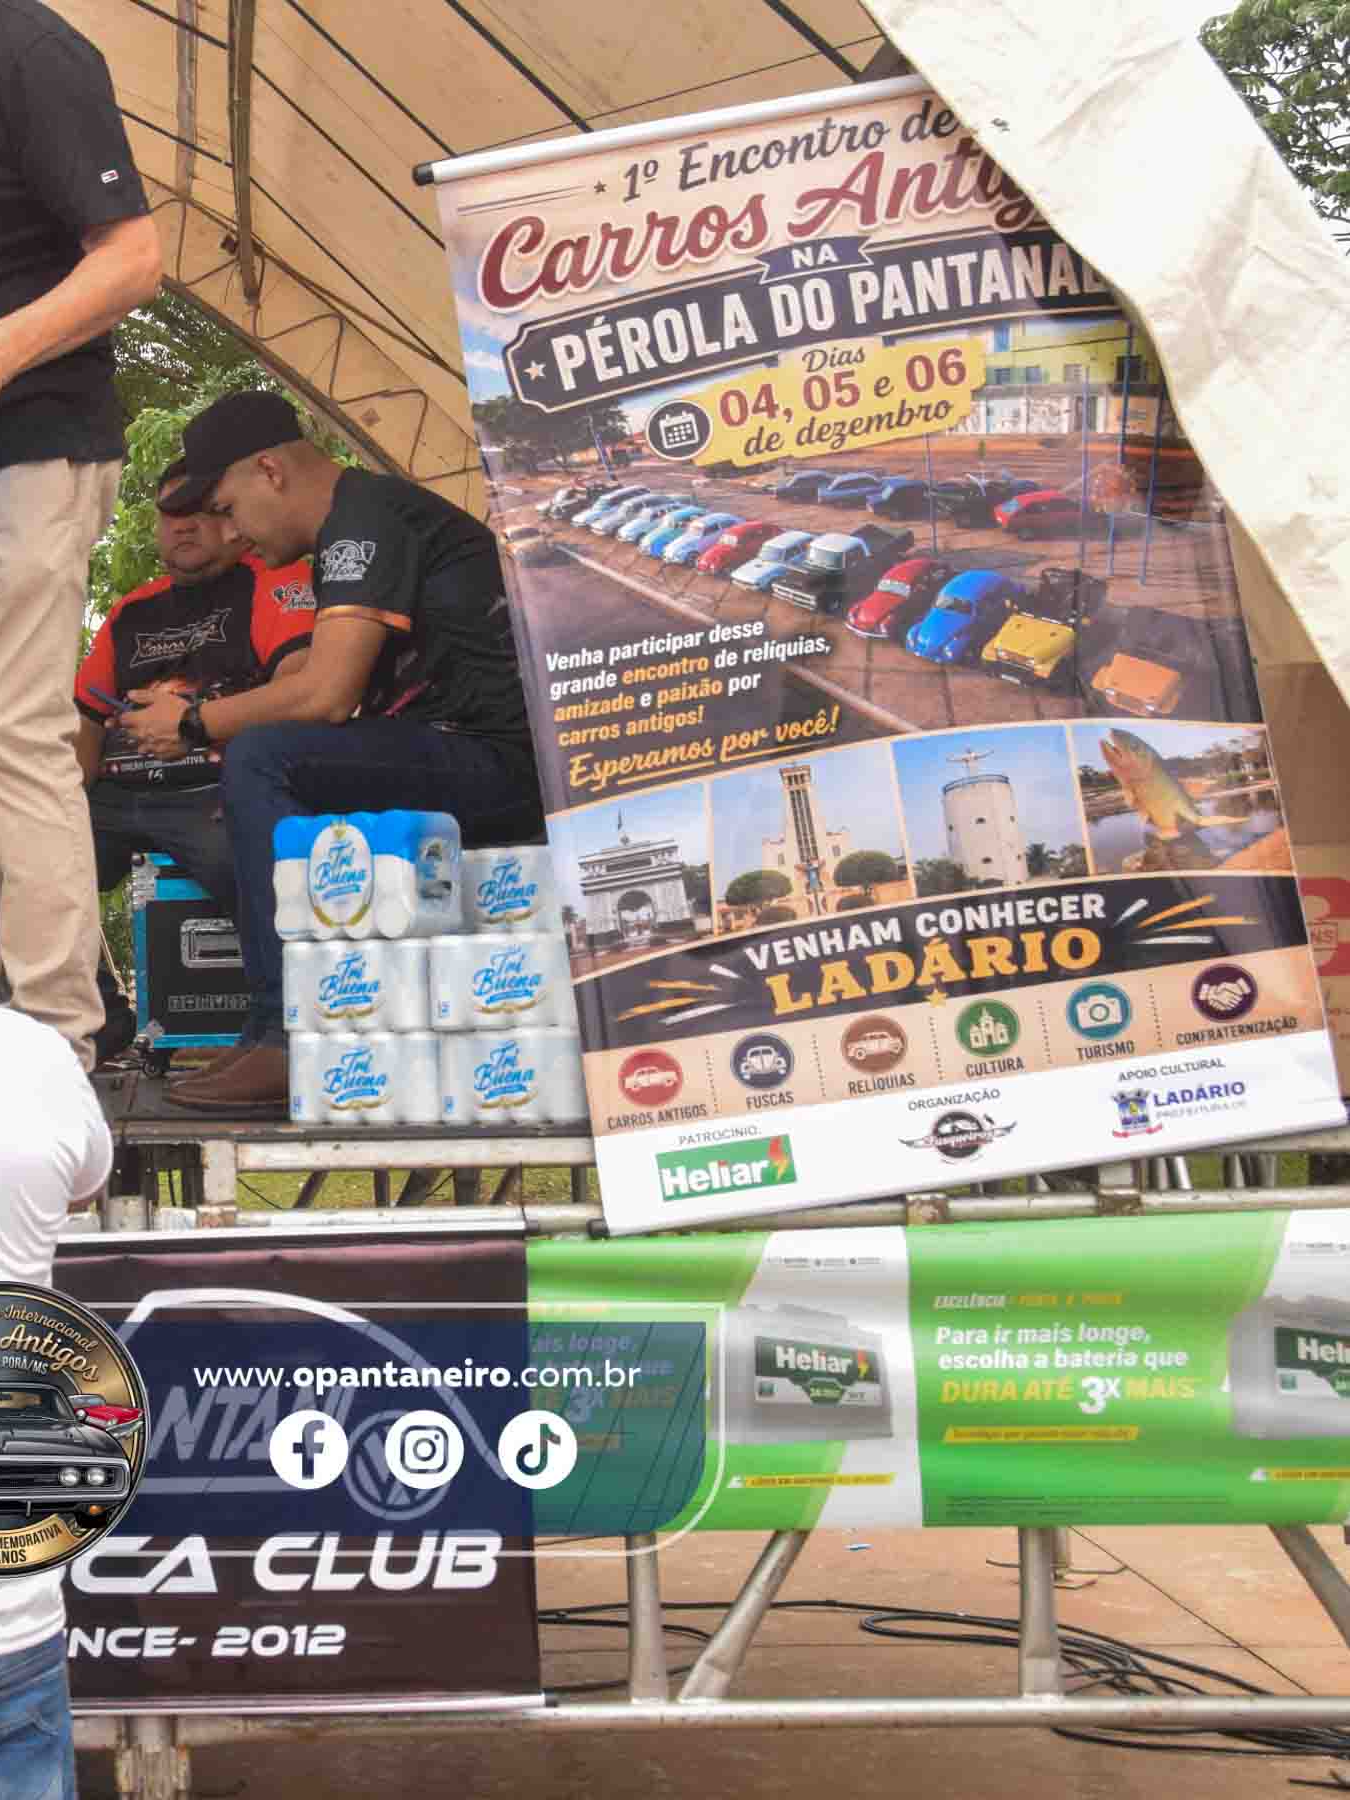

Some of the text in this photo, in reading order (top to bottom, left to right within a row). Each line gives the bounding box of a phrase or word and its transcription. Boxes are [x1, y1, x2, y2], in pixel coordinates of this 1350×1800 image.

[678, 115, 891, 191] Encontro
[901, 97, 961, 143] de
[480, 192, 769, 307] Carros
[792, 239, 839, 269] NA
[549, 299, 755, 391] PÉROLA
[768, 271, 835, 337] DO
[802, 344, 865, 373] Dias
[719, 346, 967, 427] 04, 05 e 06
[743, 396, 955, 459] de dezembro
[545, 620, 764, 672] Venha participar desse
[550, 635, 832, 700] grande encontro de relíquias,
[554, 673, 761, 722] amizade e paixão por
[558, 705, 705, 747] carros antigos!
[569, 704, 841, 792] Esperamos por você!
[329, 841, 356, 869] Tri
[314, 862, 367, 890] Buena
[492, 860, 522, 884] Tri
[476, 880, 539, 908] Buena
[745, 892, 1107, 972] VENHAM CONHECER
[336, 957, 367, 980] Tri
[491, 951, 526, 973] Tri
[766, 927, 1102, 1017] LADÁRIO
[319, 975, 380, 1001] Buena
[474, 968, 544, 997] Buena
[1175, 1015, 1298, 1047] CONFRATERNIZAÇÃO
[341, 1049, 374, 1074] Tri
[490, 1044, 520, 1068] Tri
[1076, 1040, 1136, 1061] TURISMO
[323, 1067, 388, 1094] Buena
[474, 1064, 536, 1091] Buena
[965, 1056, 1024, 1078] CULTURA
[1118, 1057, 1225, 1083] APOIO CULTURAL
[847, 1073, 916, 1097] RELÍQUIAS
[1153, 1081, 1247, 1108] LADÁRIO
[746, 1091, 794, 1111] FUSCAS
[907, 1088, 1001, 1112] ORGANIZAÇÃO
[607, 1103, 708, 1132] CARROS ANTIGOS
[660, 1158, 768, 1199] Heliar
[936, 1320, 1151, 1345] Para ir mais longe,
[775, 1345, 853, 1375] Heliar
[938, 1347, 1189, 1371] escolha a bateria que
[940, 1378, 1018, 1404] DURA
[1022, 1375, 1074, 1402] ATÉ
[1125, 1375, 1196, 1399] MAIS
[253, 1529, 503, 1592] CLUB
[211, 1624, 347, 1657] 2012
